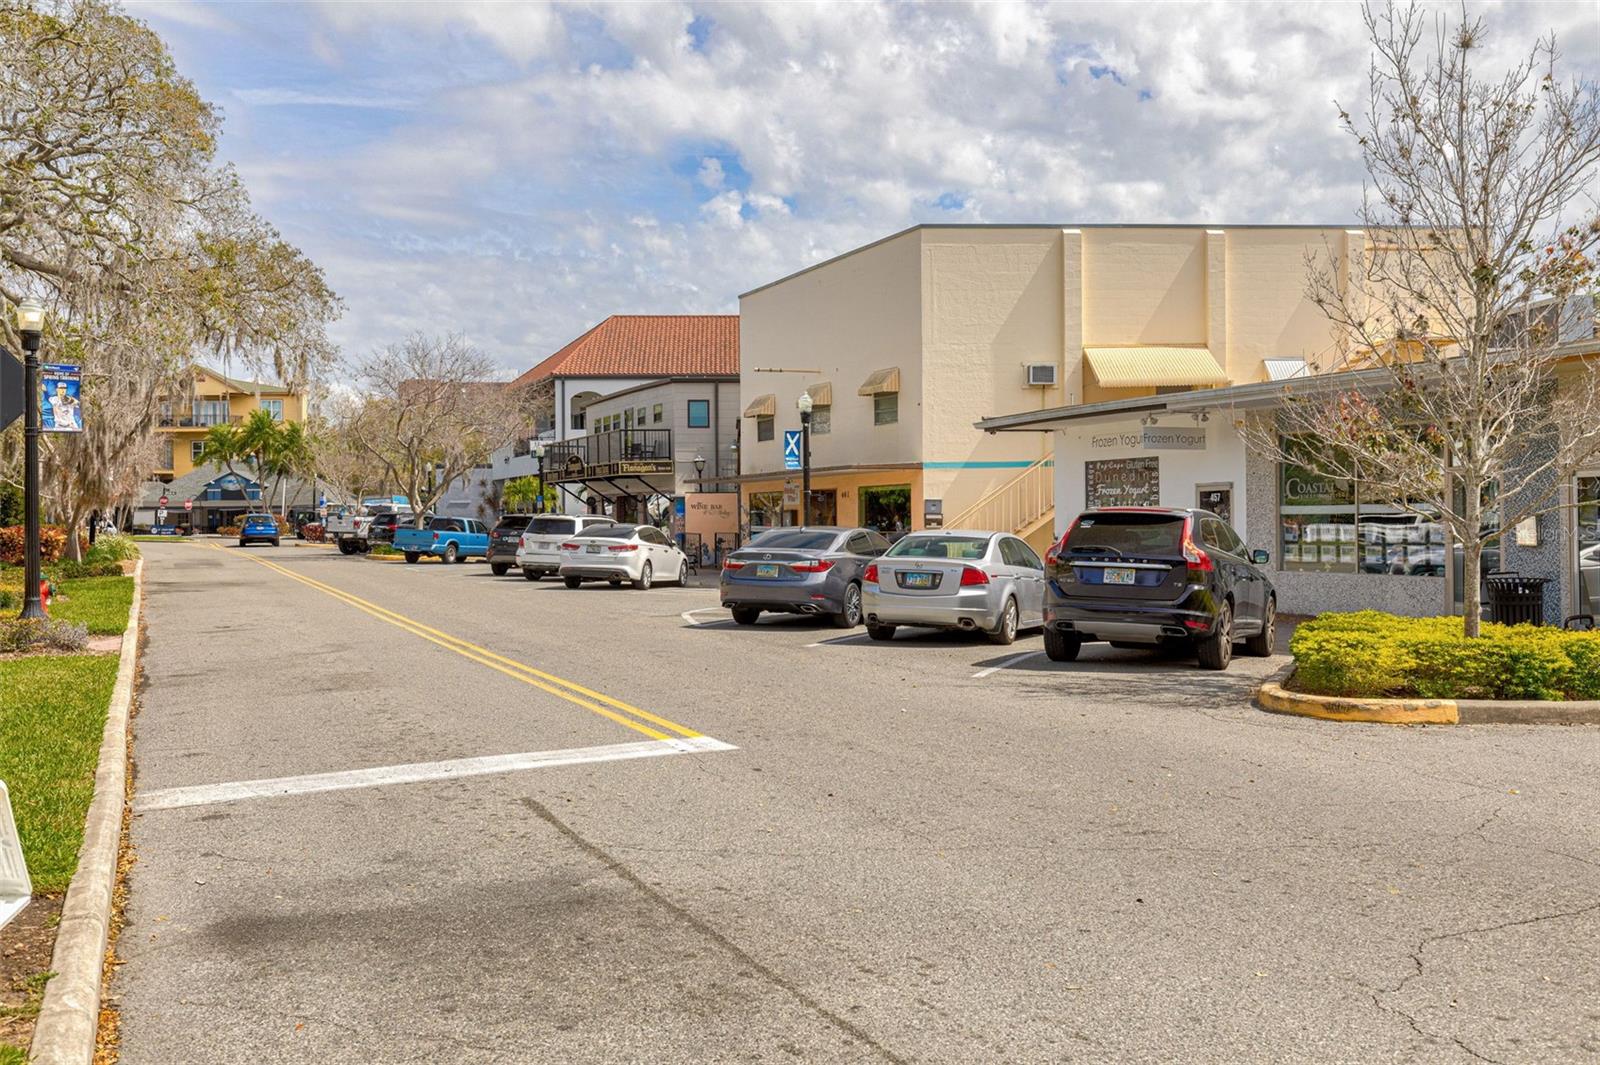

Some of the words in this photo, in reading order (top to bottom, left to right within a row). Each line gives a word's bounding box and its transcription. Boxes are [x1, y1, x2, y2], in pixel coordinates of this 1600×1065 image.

[1092, 436, 1118, 447] Frozen
[1119, 434, 1141, 447] Yogu
[1143, 433, 1176, 444] Frozen
[1175, 433, 1206, 446] Yogurt
[1095, 470, 1150, 483] Dunedin
[1095, 484, 1122, 496] Frozen
[1122, 483, 1150, 499] Yogurt
[1210, 493, 1221, 502] 457
